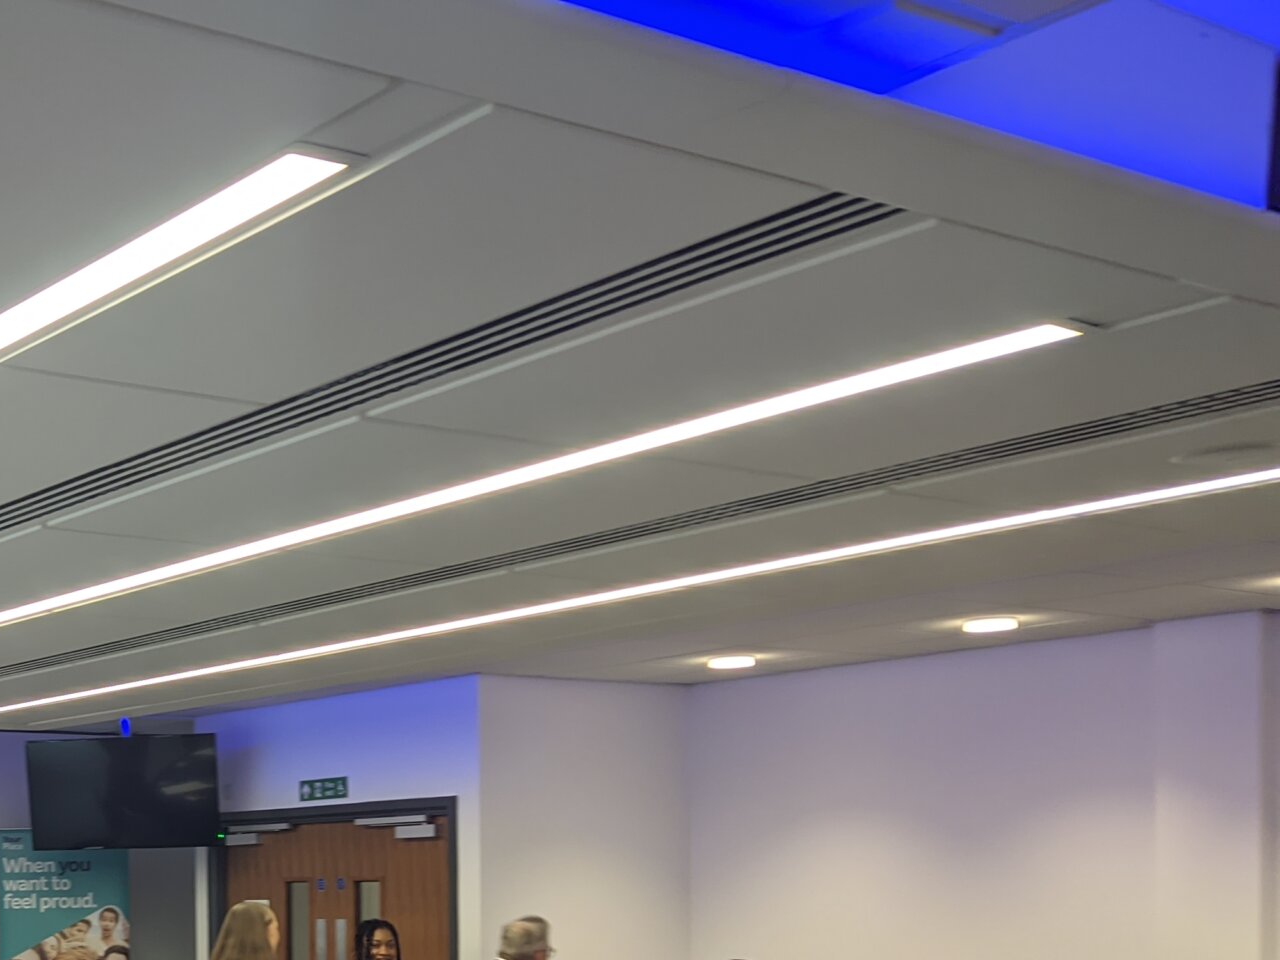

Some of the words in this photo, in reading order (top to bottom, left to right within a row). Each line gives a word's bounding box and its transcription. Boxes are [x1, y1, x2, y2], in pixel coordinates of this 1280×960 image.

[2, 857, 57, 873] When
[58, 860, 92, 875] you
[2, 877, 49, 891] want
[51, 876, 72, 891] to
[3, 893, 37, 909] feel
[39, 892, 97, 912] proud.
